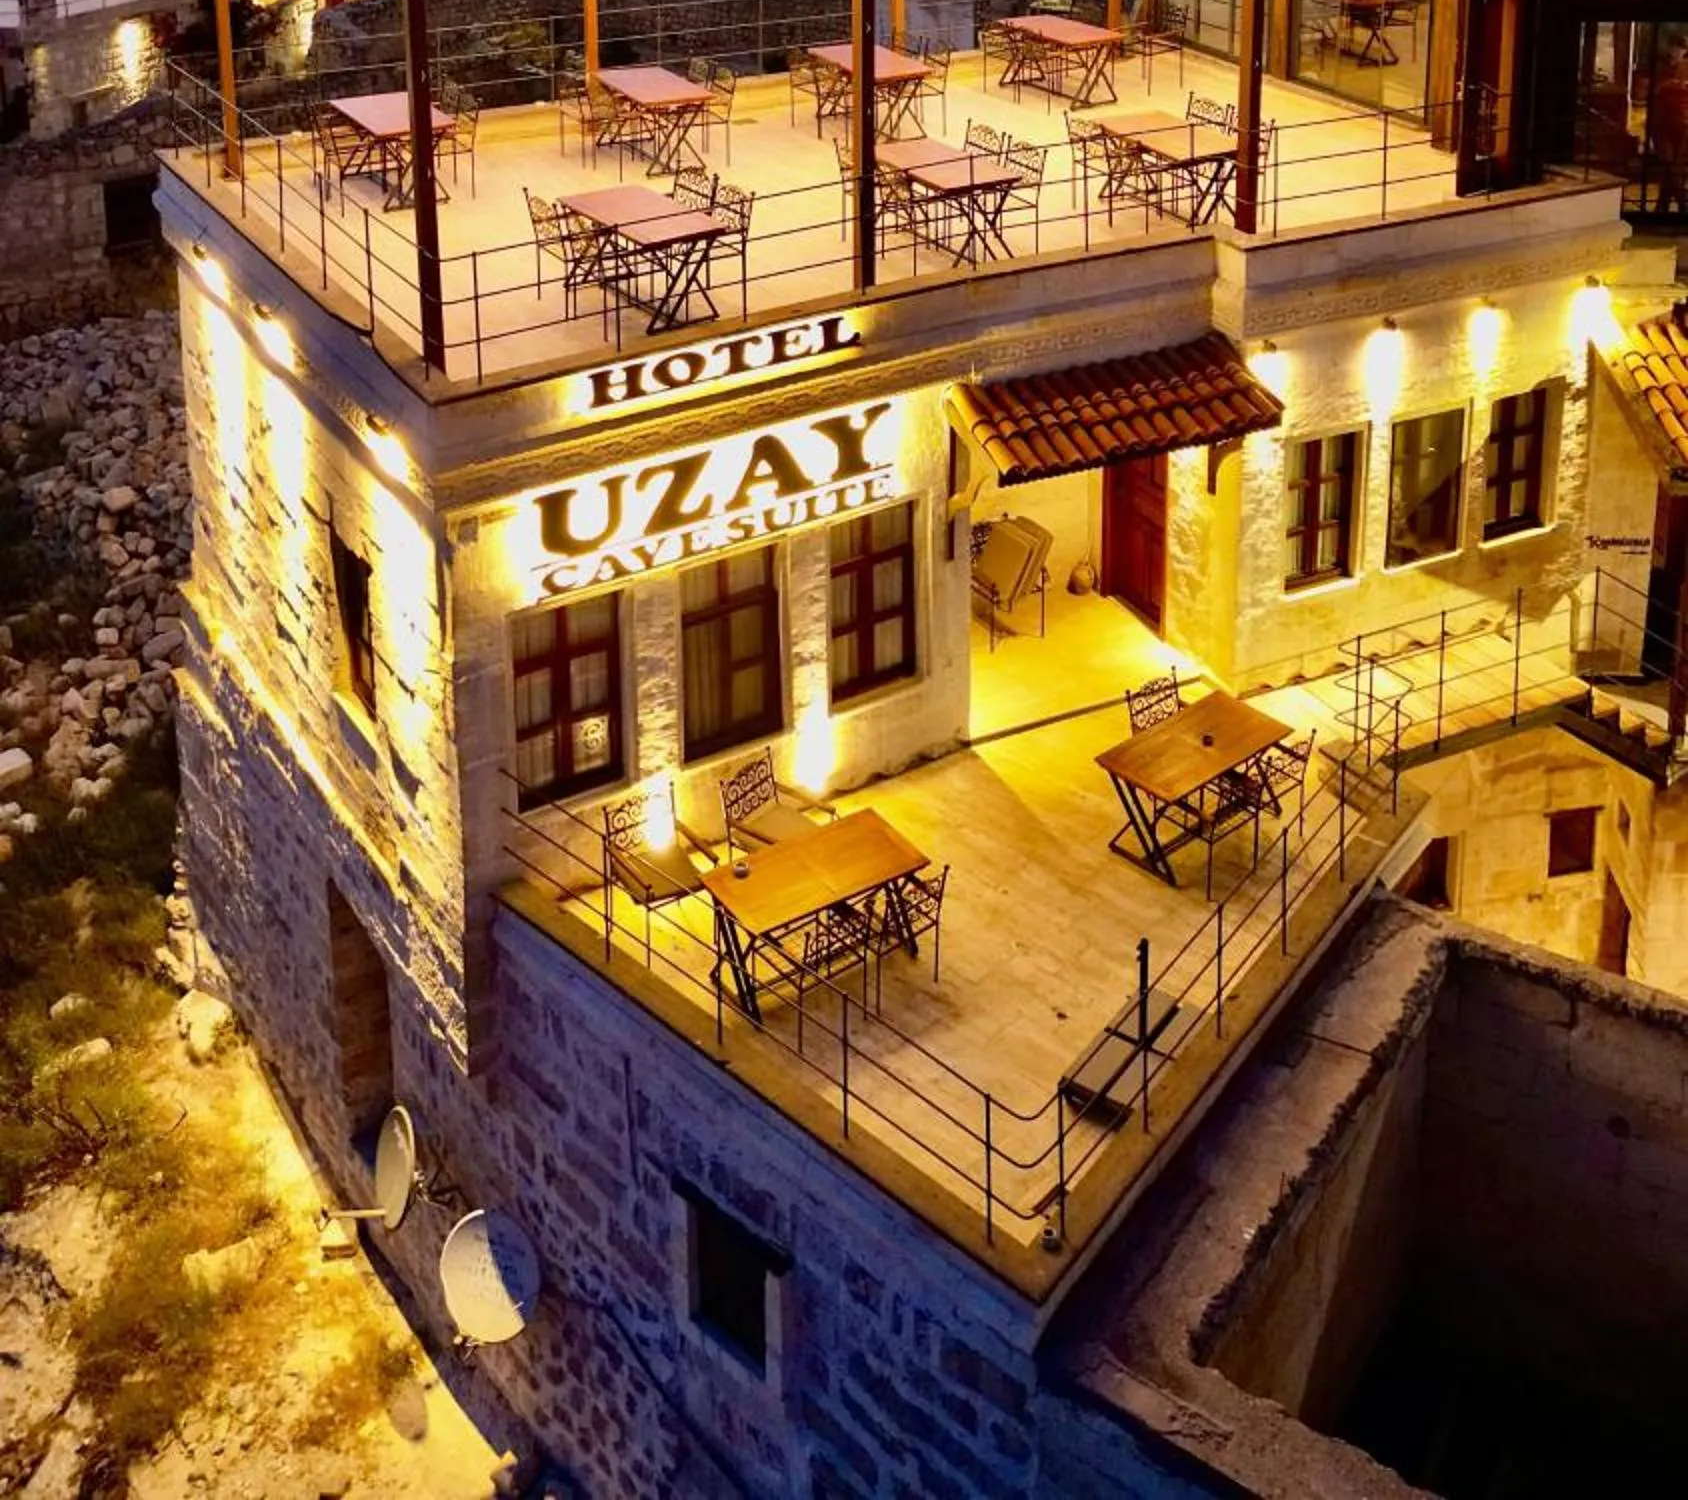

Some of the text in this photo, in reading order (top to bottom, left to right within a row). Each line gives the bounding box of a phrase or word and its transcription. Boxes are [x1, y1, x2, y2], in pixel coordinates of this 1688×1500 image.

[588, 316, 862, 409] HOTEL
[533, 403, 893, 558] UZAY
[727, 473, 892, 542] SUITE
